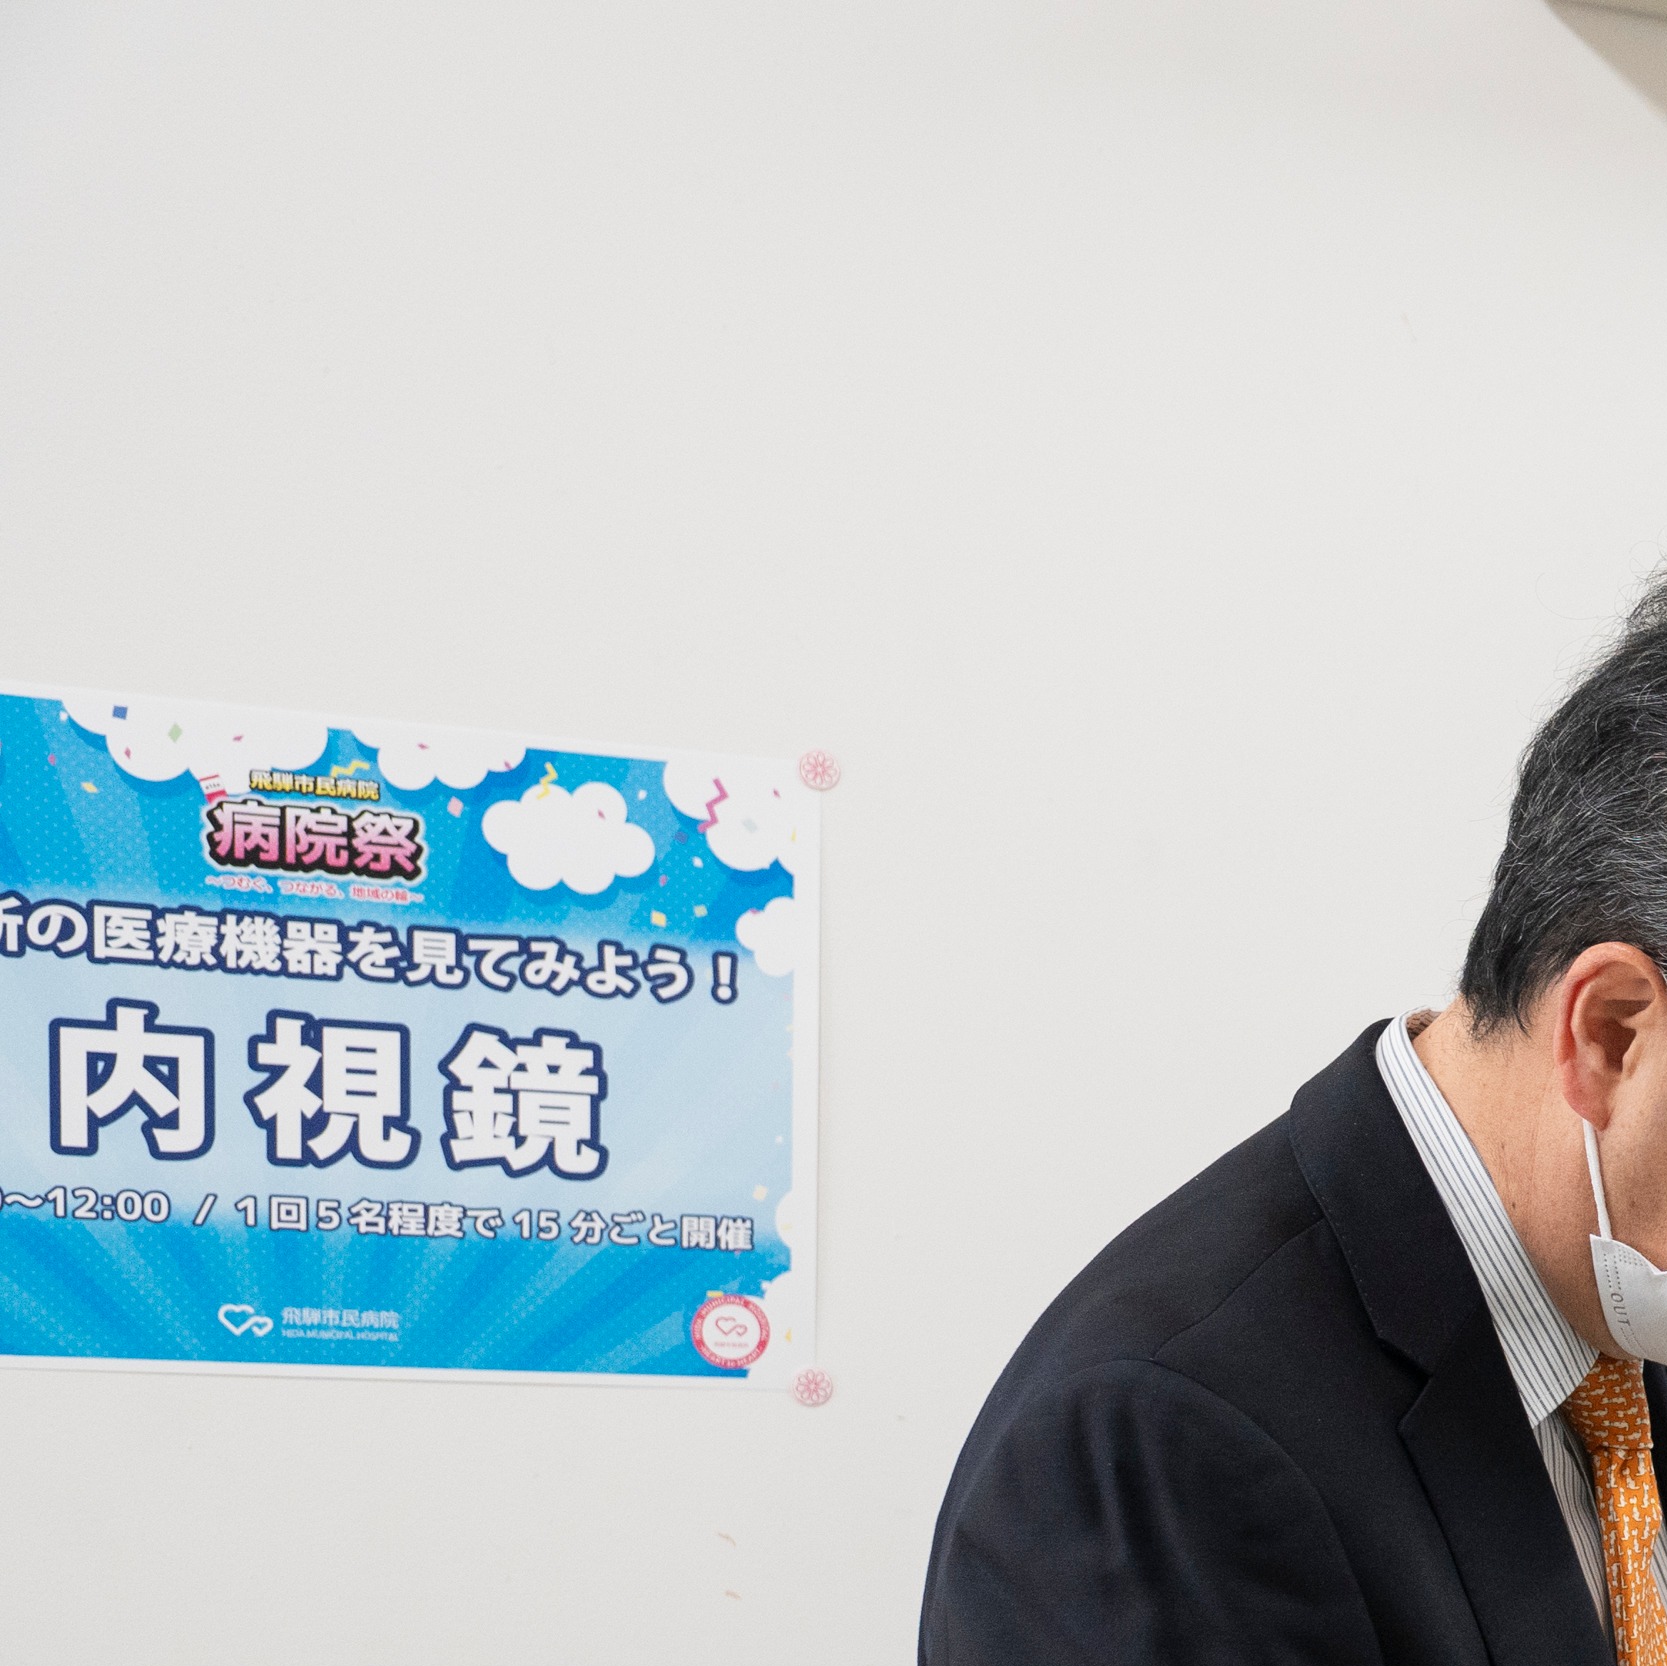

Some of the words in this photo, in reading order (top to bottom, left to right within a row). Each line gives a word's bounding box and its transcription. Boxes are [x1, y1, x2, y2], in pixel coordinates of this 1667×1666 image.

[209, 800, 422, 877] 病院祭
[53, 1000, 606, 1178] 内視鏡
[1611, 1293, 1631, 1326] OUT
